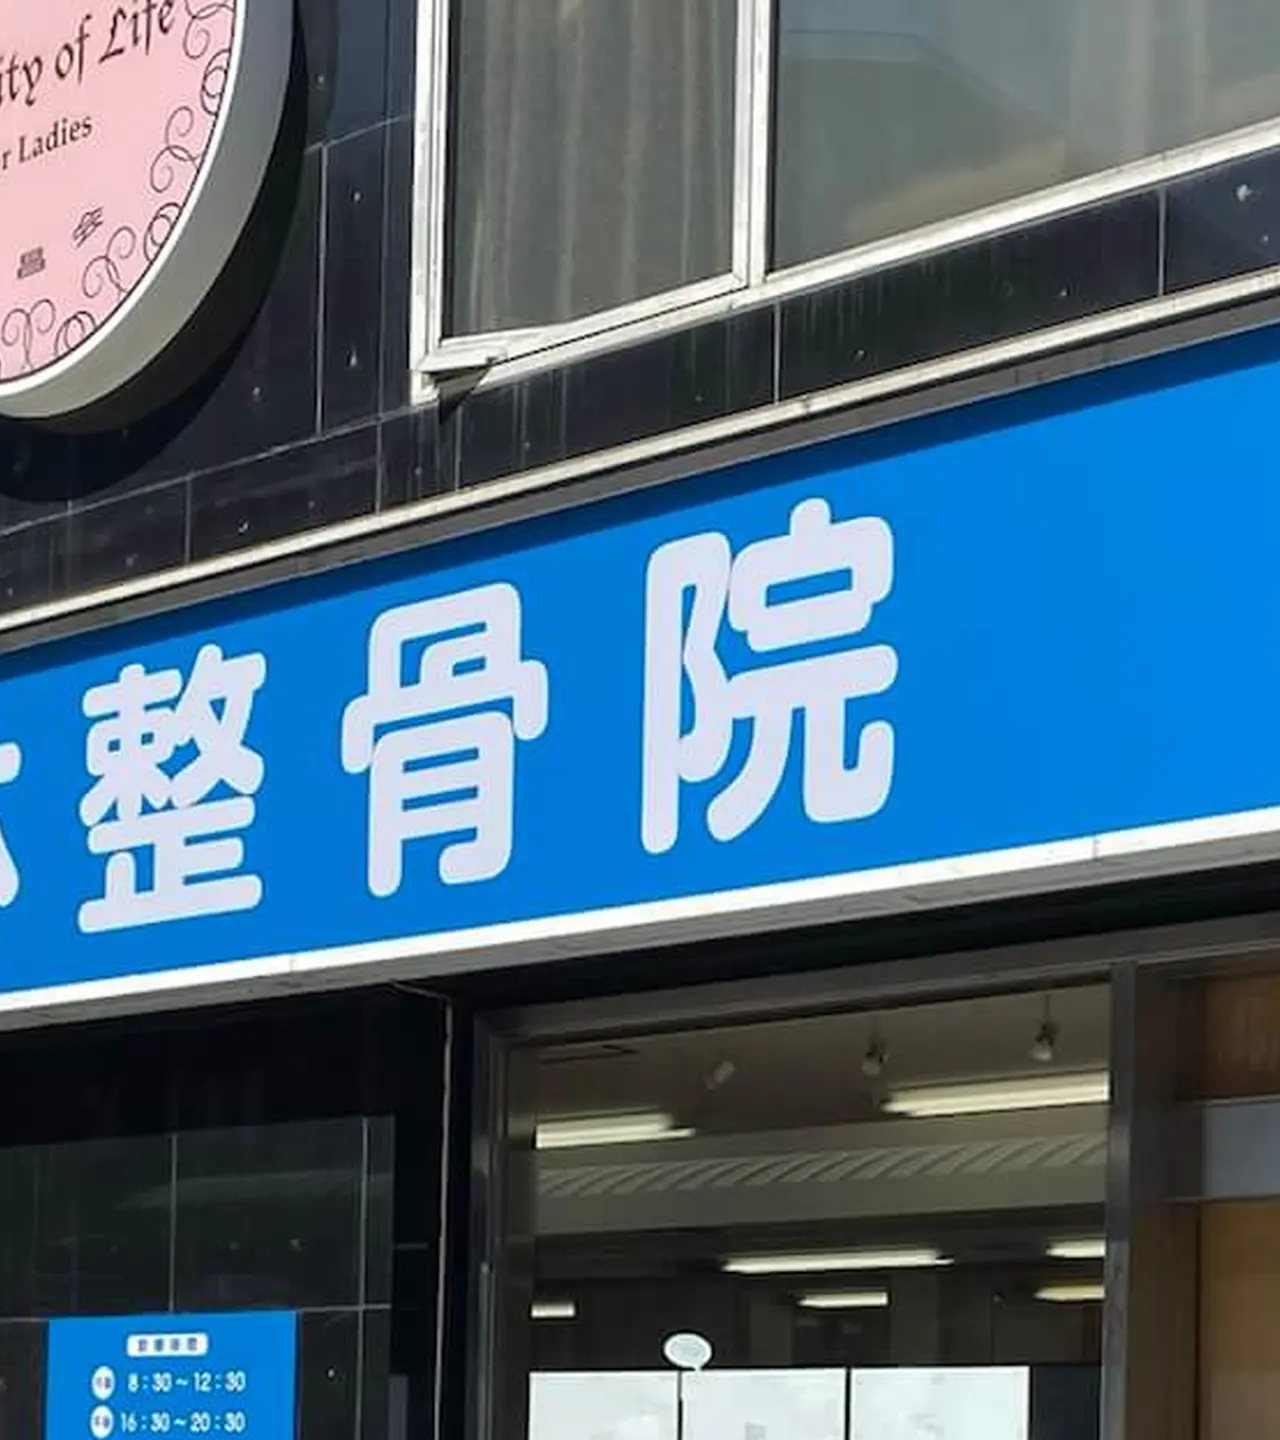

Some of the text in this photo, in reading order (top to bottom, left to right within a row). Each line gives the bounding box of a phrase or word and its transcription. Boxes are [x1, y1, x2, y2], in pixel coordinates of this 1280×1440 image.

[55, 14, 92, 84] of
[98, 0, 175, 64] Life
[19, 116, 93, 164] Ladies
